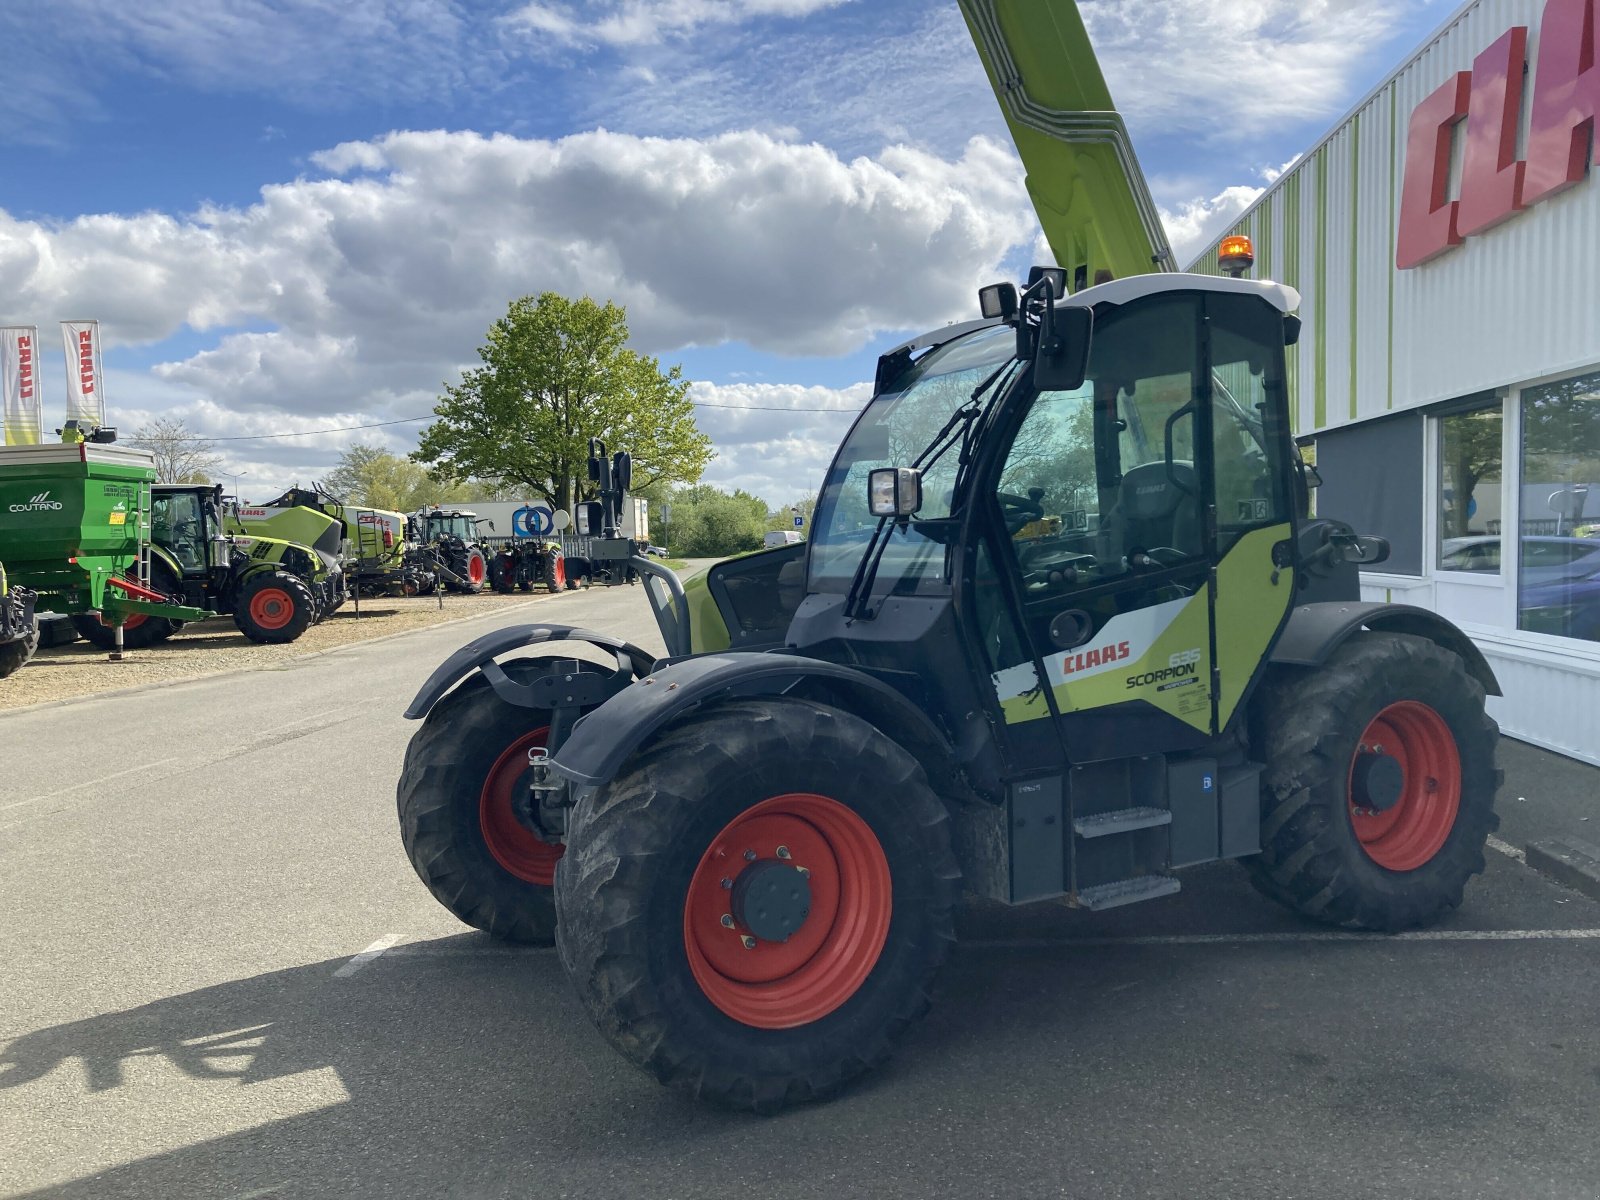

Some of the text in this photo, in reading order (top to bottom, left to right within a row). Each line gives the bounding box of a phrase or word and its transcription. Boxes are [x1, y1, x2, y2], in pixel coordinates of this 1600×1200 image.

[18, 336, 33, 399] CLAAS
[79, 331, 94, 394] CLAAS
[9, 501, 63, 513] COUTAND
[1063, 641, 1130, 675] CLAAS
[1126, 663, 1195, 690] SCORPION
